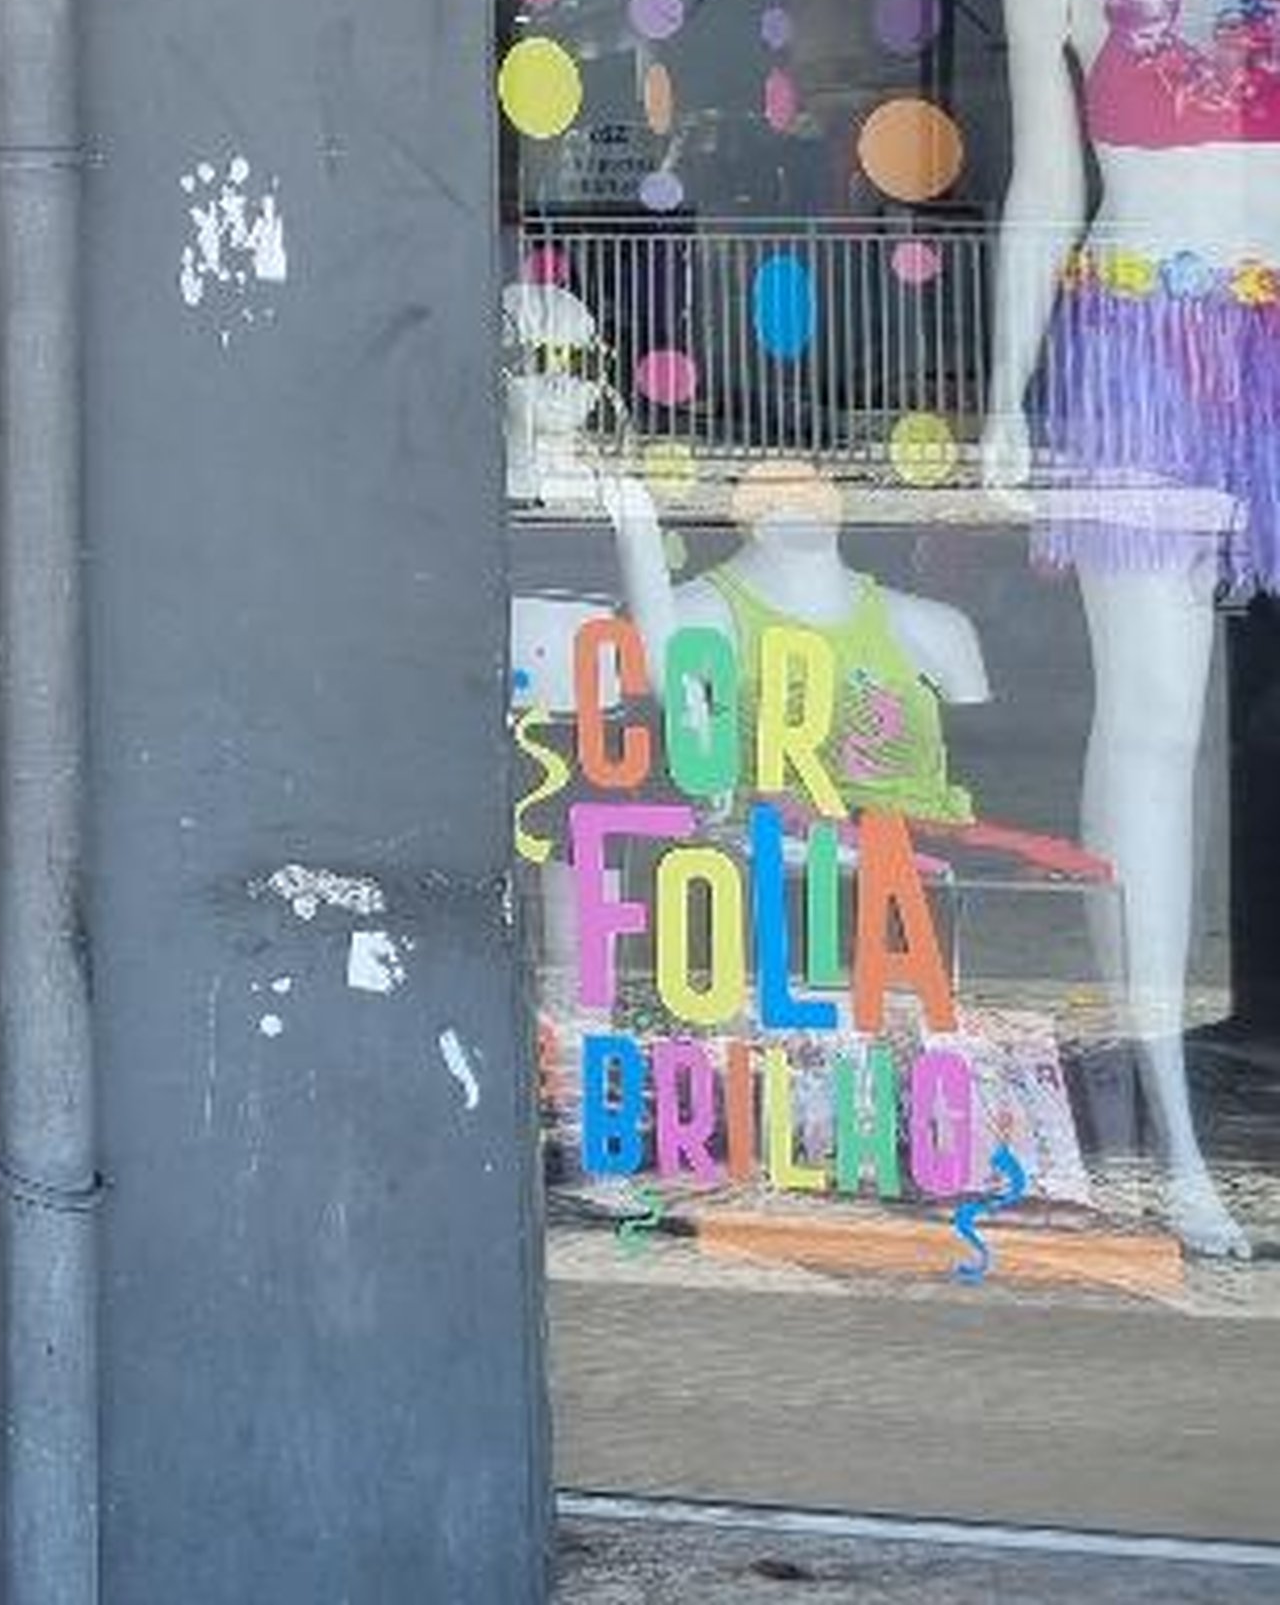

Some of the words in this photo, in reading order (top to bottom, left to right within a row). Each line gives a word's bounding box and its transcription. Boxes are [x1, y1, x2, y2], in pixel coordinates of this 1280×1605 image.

[571, 612, 849, 819] COR
[567, 801, 959, 1033] FOLIA
[580, 1034, 978, 1198] BRILHO
